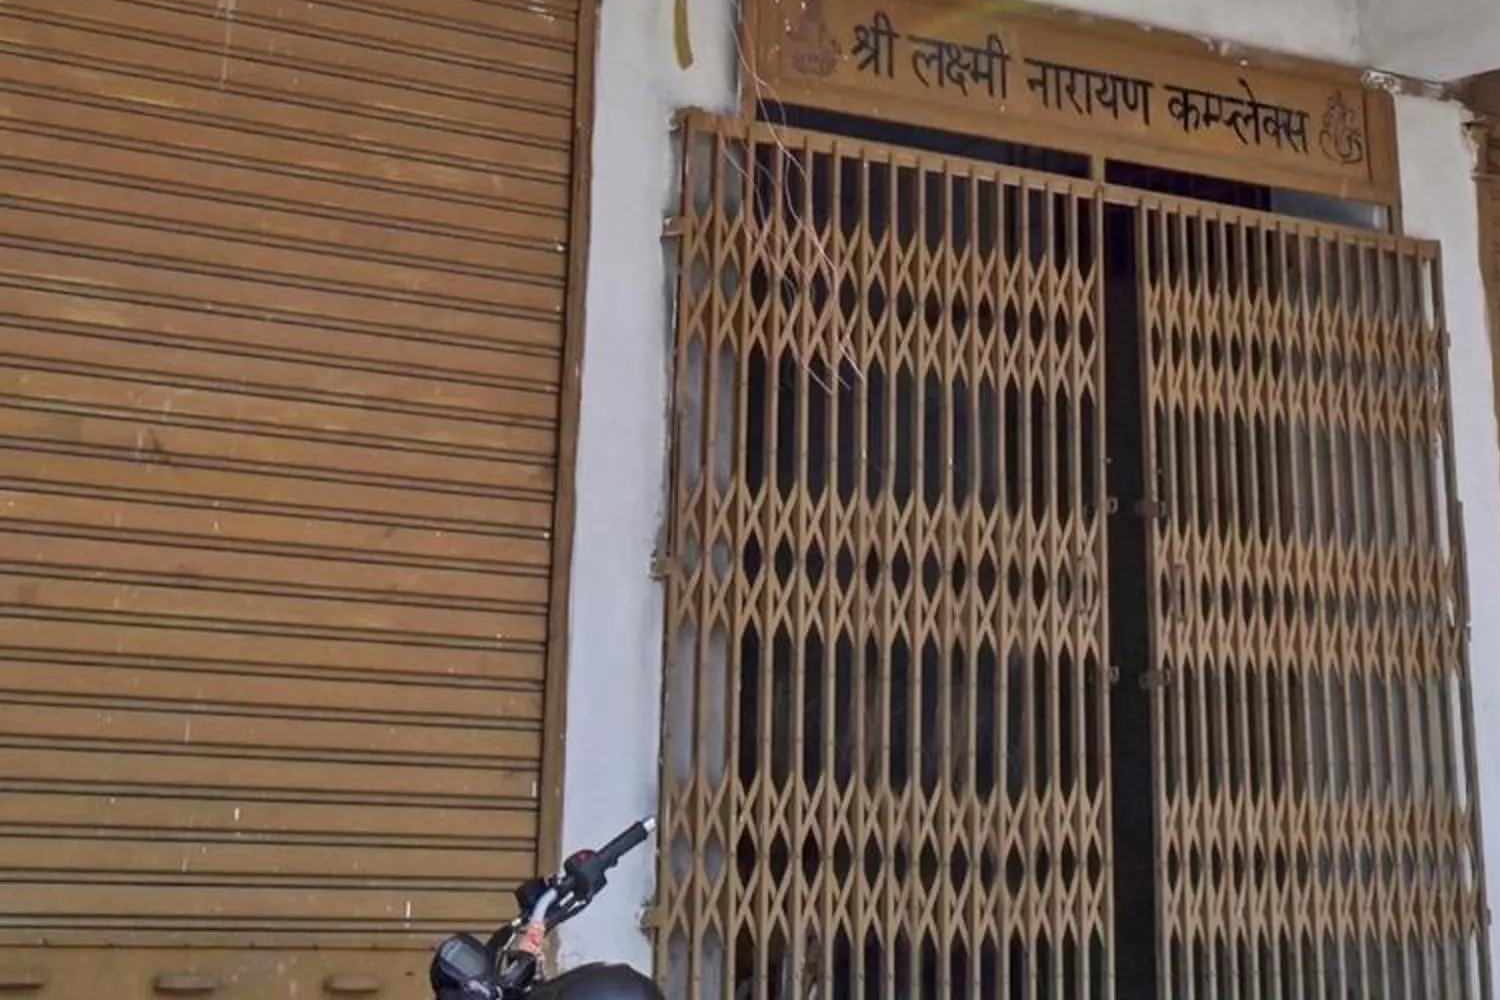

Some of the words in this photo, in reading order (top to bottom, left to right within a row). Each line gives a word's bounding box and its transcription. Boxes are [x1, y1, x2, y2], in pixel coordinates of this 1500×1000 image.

[851, 10, 900, 79] श्री
[906, 33, 1012, 99] लक्ष्मी
[1024, 58, 1154, 126] नारायण
